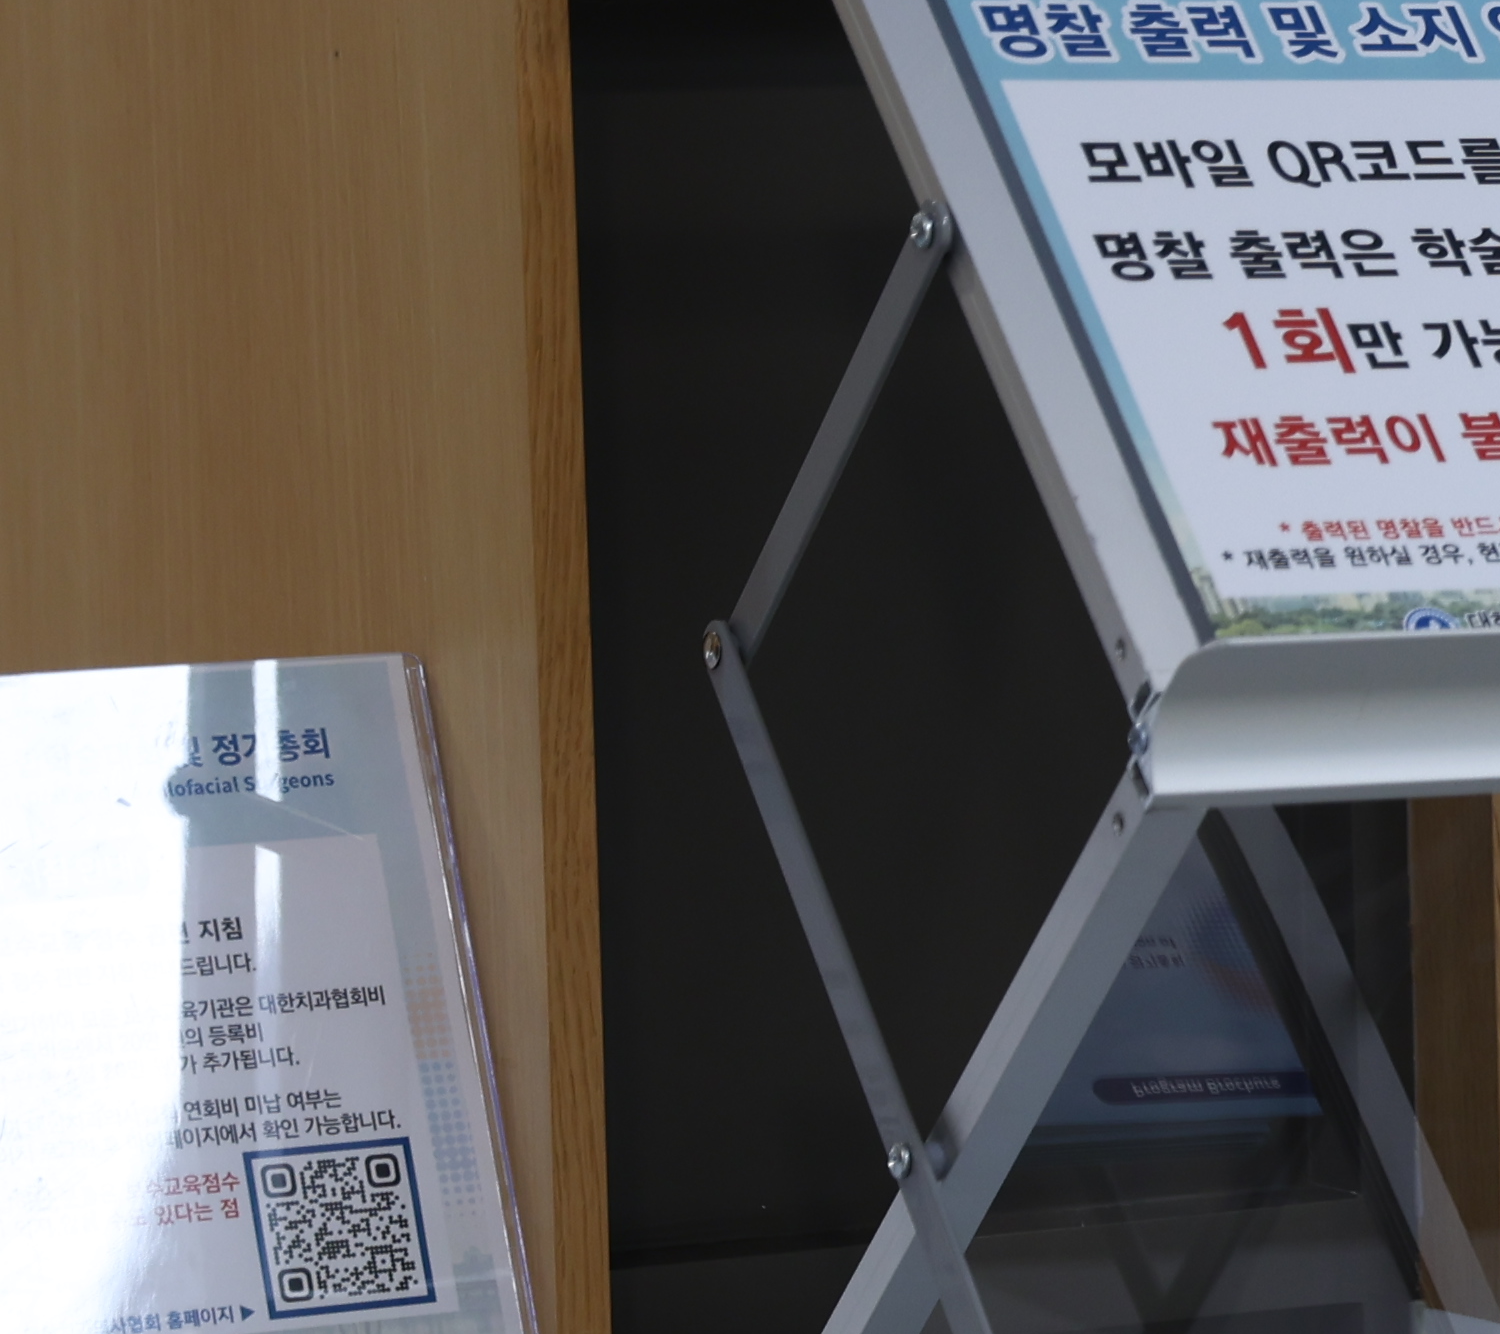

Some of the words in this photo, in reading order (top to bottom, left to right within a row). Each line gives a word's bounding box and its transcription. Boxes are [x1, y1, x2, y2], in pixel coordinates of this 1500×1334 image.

[978, 3, 1111, 58] 명찰
[1128, 4, 1253, 58] 출력
[1269, 5, 1339, 58] 및
[1358, 5, 1477, 58] 소지
[1080, 139, 1256, 188] 모바일
[1092, 229, 1213, 284] 명찰
[1229, 229, 1399, 281] 출력은
[1221, 307, 1410, 374] 1회만
[1212, 413, 1447, 468] 재출력이
[1301, 519, 1371, 542] 출력된
[1376, 517, 1445, 540] 명찰을
[1243, 544, 1337, 570] 재출력을
[1345, 544, 1412, 567] 원하실
[1419, 543, 1474, 566] 경우,
[198, 917, 243, 943] 지침
[181, 952, 257, 976] 드립니다.
[258, 985, 387, 1015] 대한치과협회비
[208, 1022, 264, 1046] 등록비
[202, 1046, 300, 1073] 추가됩니다.
[183, 1095, 239, 1122] 연회비
[245, 1093, 281, 1117] 미납
[286, 1088, 342, 1112] 여부는
[262, 1119, 300, 1140] 확인
[304, 1110, 401, 1137] 가능합니다.
[153, 1201, 213, 1226] 있다는
[220, 1198, 241, 1219] 점
[167, 1306, 235, 1330] 홈페이지
